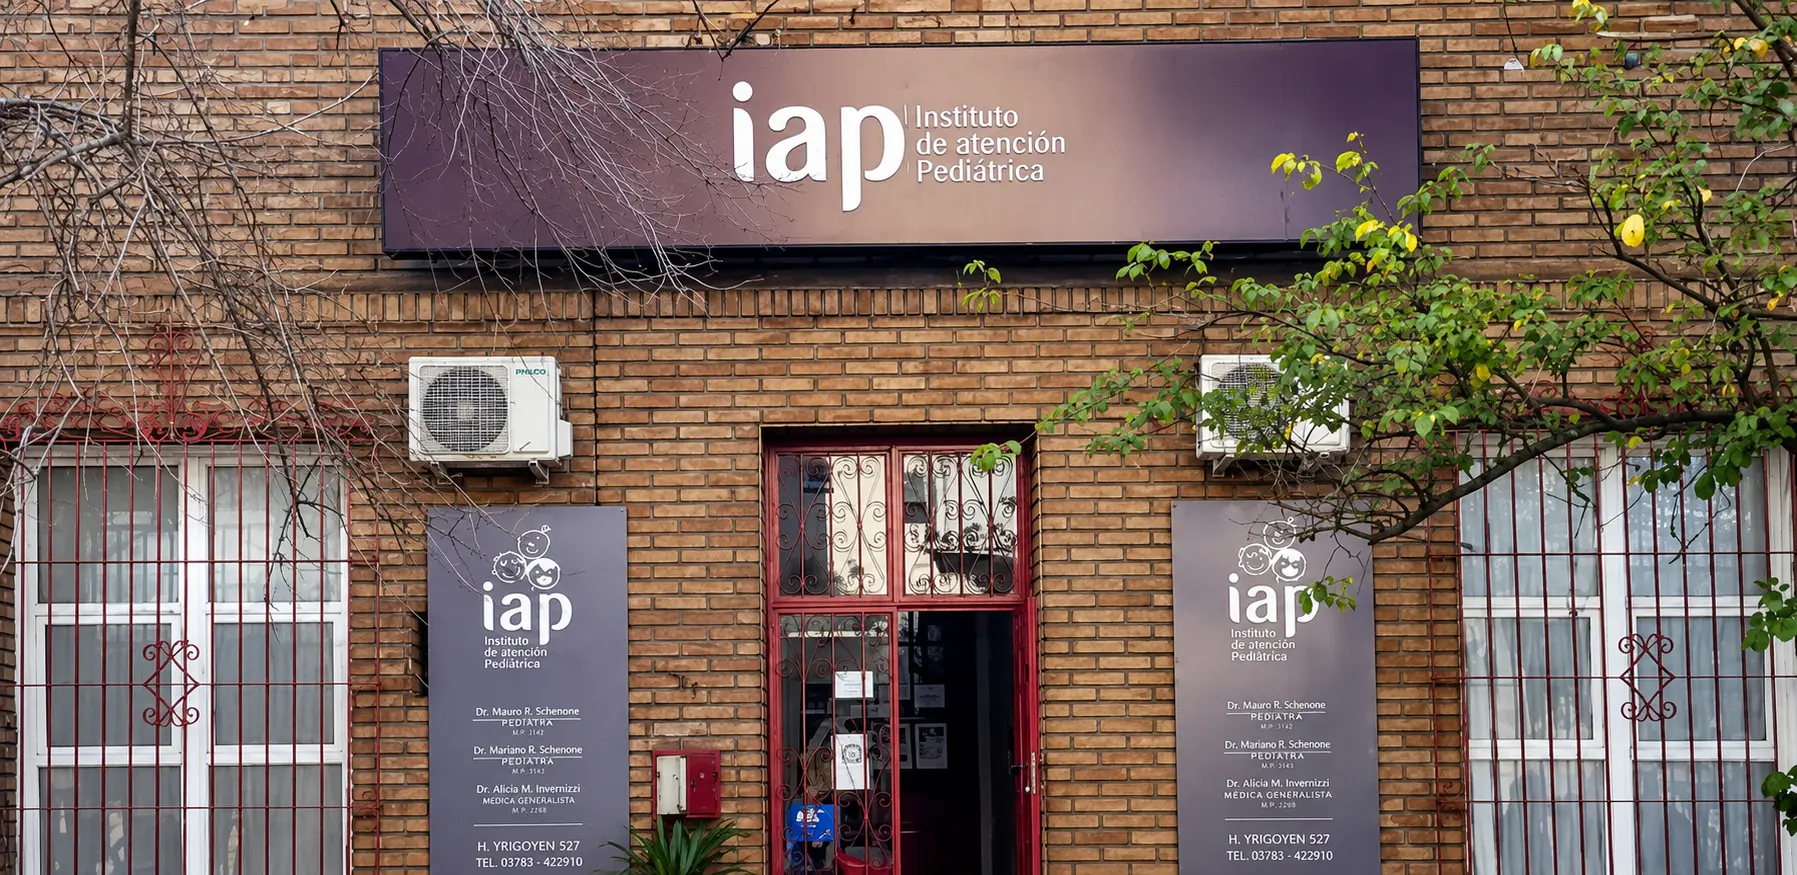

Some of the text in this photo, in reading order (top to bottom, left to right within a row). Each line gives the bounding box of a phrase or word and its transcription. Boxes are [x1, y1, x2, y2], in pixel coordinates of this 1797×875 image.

[916, 104, 1019, 128] Instituto
[732, 81, 906, 212] iap
[916, 130, 1066, 156] de atención
[917, 159, 1045, 183] Pediátrica
[515, 368, 547, 376] PHILCO
[1228, 572, 1320, 638] iap
[482, 581, 573, 646] iap
[1231, 628, 1276, 638] Instituto
[484, 636, 529, 646] Instituto
[1231, 639, 1296, 650] de atención
[484, 646, 548, 657] de atención
[1231, 651, 1288, 662] Pediátrica
[484, 658, 541, 669] Pediátrica
[1227, 701, 1241, 710] Dr.
[1243, 700, 1272, 710] Mauro
[1284, 700, 1326, 709] Schenone
[475, 706, 580, 717] Dr. Mauro R. Schenone
[1250, 712, 1303, 721] PEDIATRA
[501, 719, 554, 727] PEDIATRA
[473, 745, 583, 755] Dr. Mariano R. Schenone
[1224, 739, 1331, 750] Dr. Mariano R. Schenone
[1250, 751, 1305, 760] PEDIATRA
[501, 757, 554, 766] PEDIATRA
[1226, 777, 1330, 788] Dr. Alicia M. Invernizzi
[476, 783, 581, 794] Dr. Alicia M. Invernizzi
[1266, 790, 1333, 799] GENERALISTA
[517, 796, 576, 805] GENERALISTA
[1228, 833, 1331, 844] H. YRIGOYEN 527
[477, 840, 580, 851] H. YRIGOYEN 527
[1226, 851, 1249, 860] TEL.
[1251, 850, 1284, 861] 03783
[1294, 850, 1333, 860] 422910
[476, 858, 498, 868] TEL.
[500, 857, 534, 868] 03783
[543, 856, 583, 867] 422910
